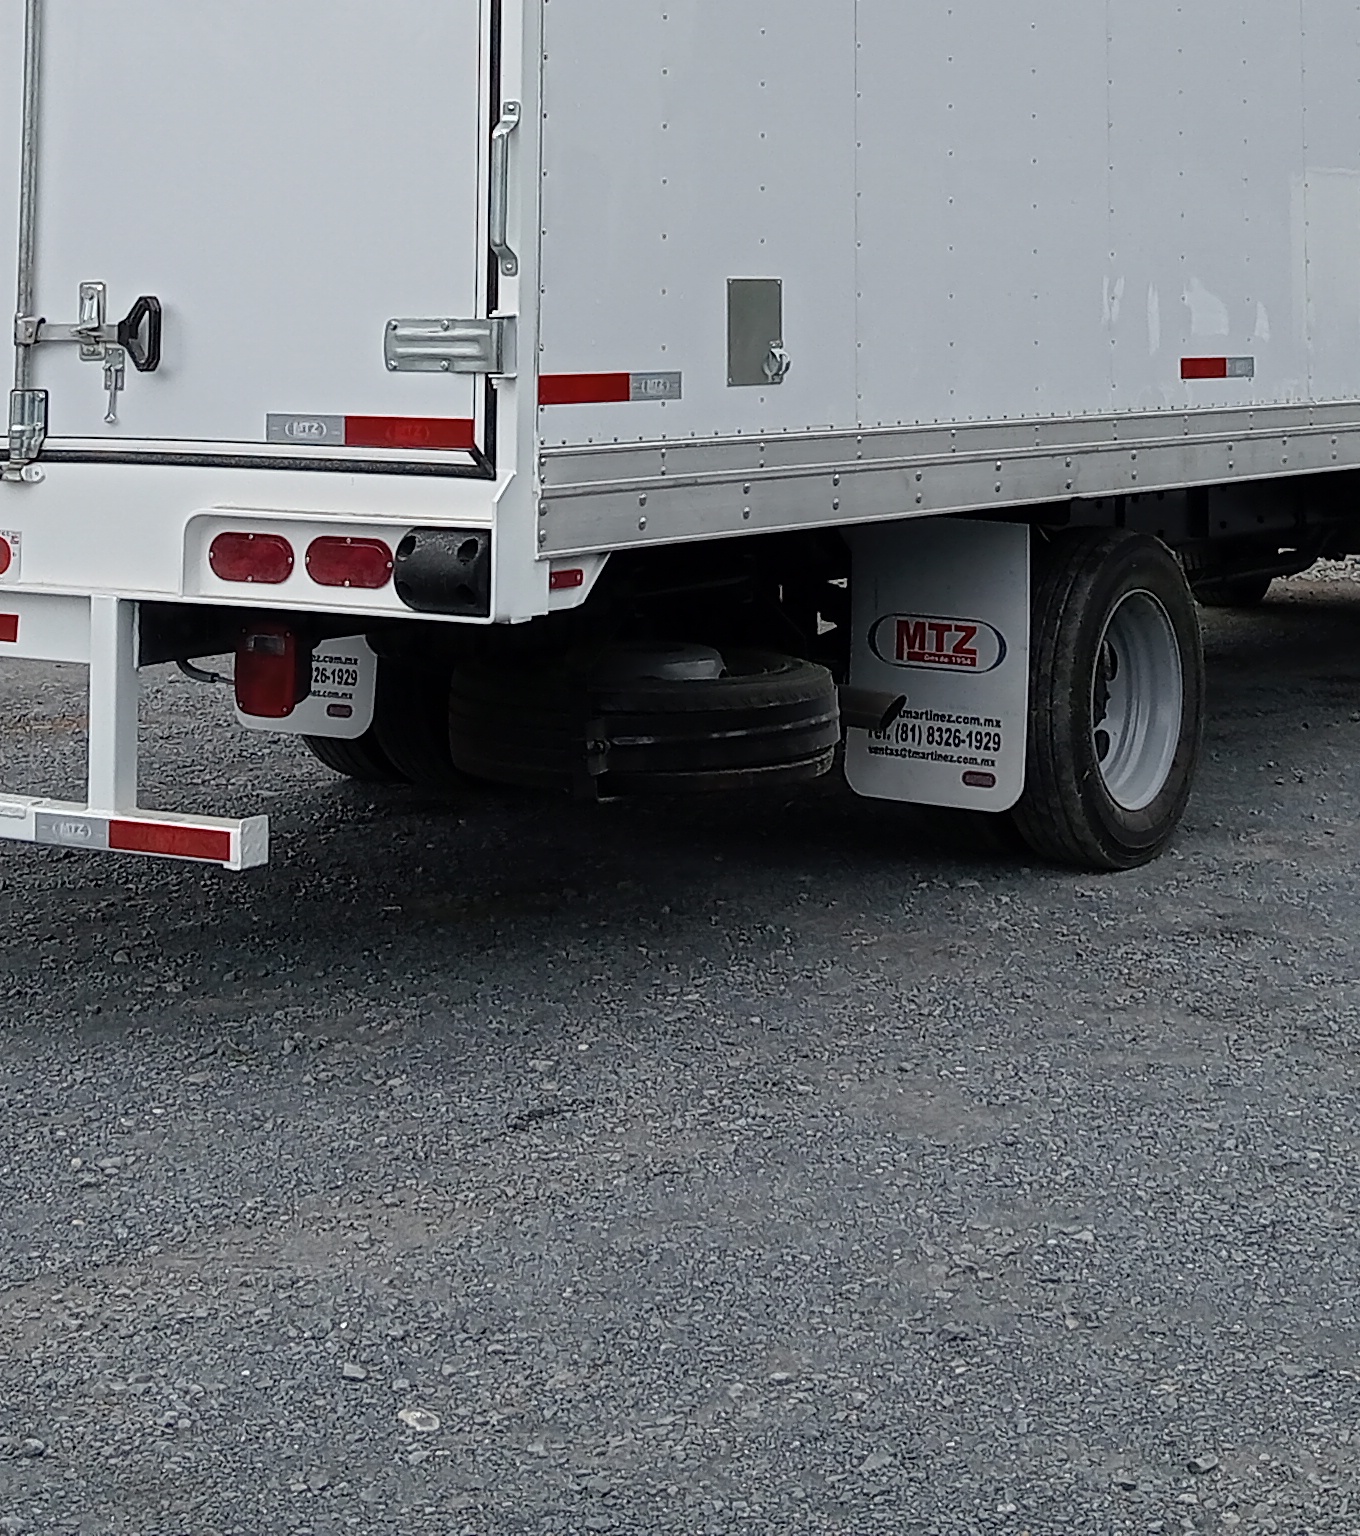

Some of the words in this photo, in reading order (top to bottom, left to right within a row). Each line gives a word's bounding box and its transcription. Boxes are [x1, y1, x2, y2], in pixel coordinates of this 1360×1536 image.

[895, 619, 978, 660] MTZ
[312, 666, 358, 687] 26-1929
[899, 708, 1002, 729] tmartinez.com.mx
[895, 722, 923, 747] (81)
[926, 725, 1001, 753] 8326-1929
